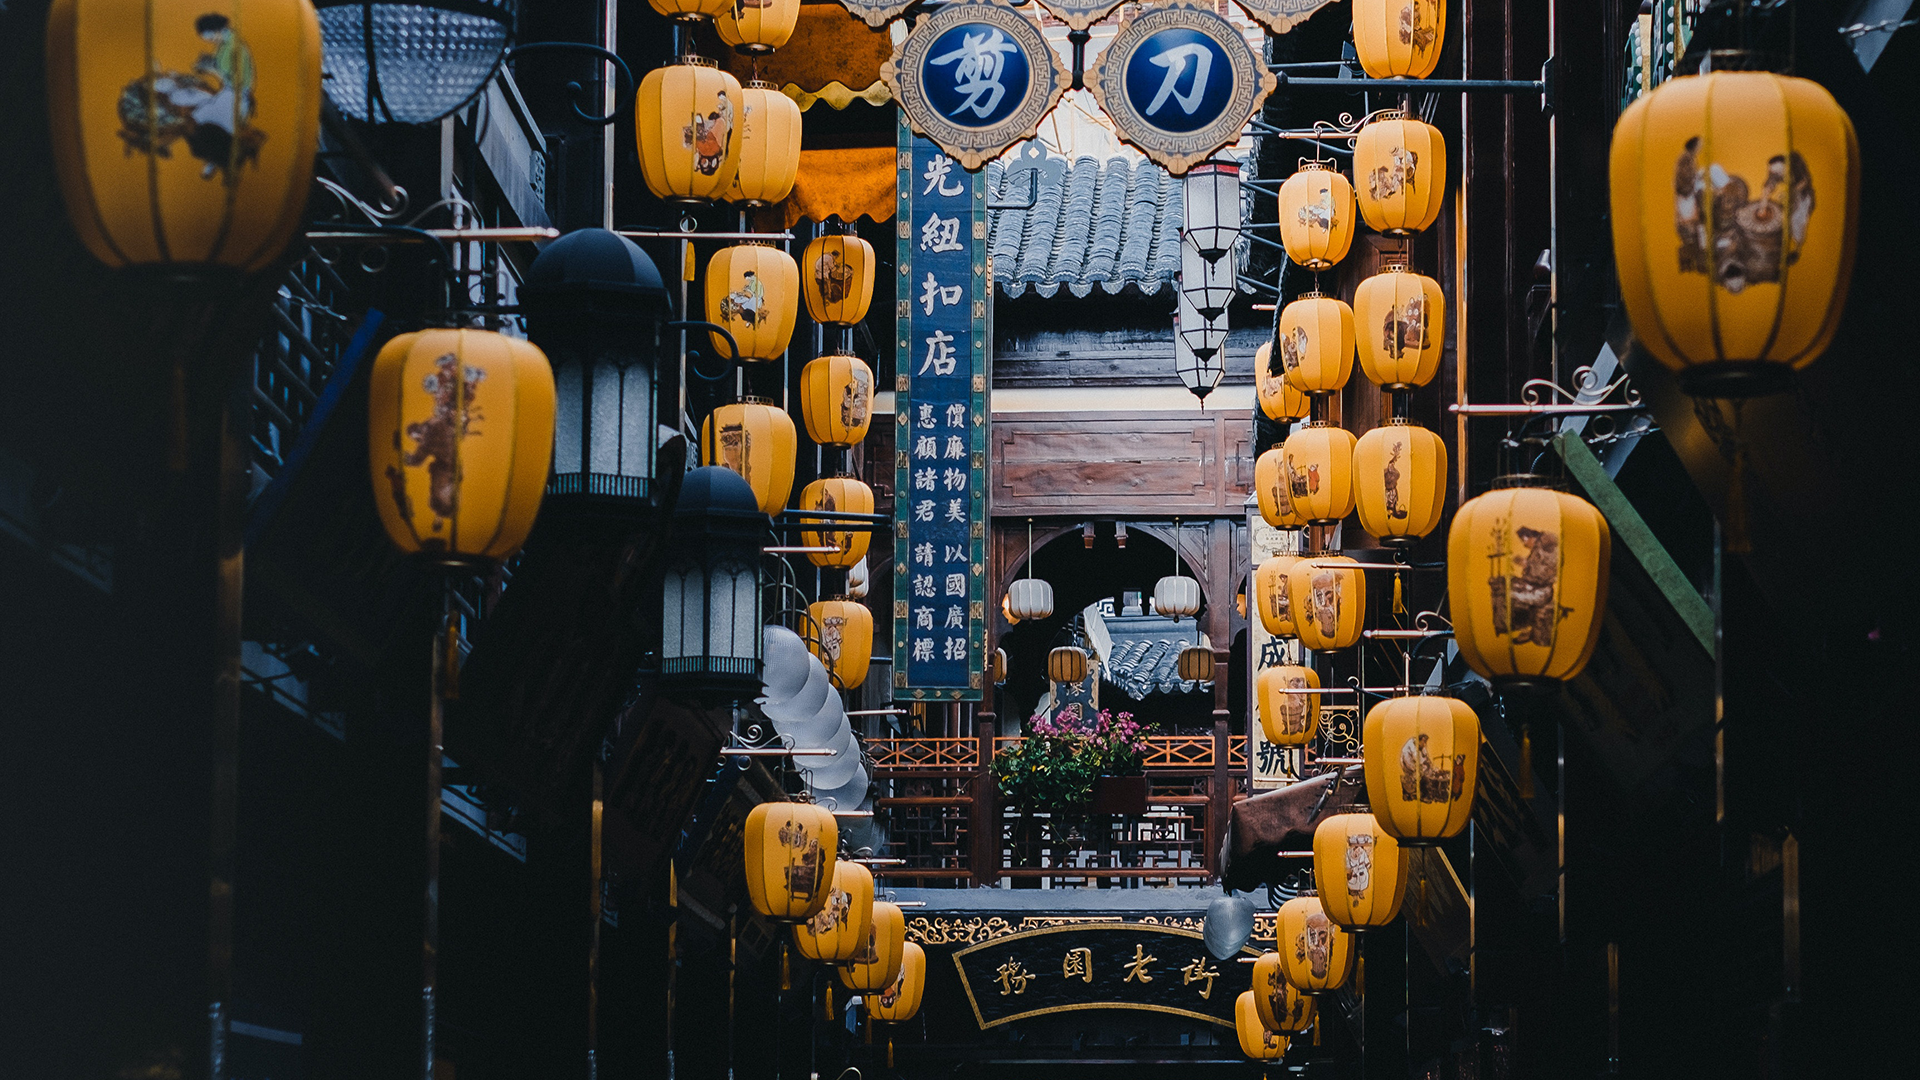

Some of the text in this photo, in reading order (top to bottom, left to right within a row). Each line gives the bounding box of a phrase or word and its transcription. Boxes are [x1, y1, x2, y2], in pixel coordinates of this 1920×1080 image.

[930, 27, 1018, 119] 剪
[1145, 42, 1214, 116] 刀
[918, 153, 964, 377] 光紐扣店
[912, 402, 938, 663] 惠顧諸君 請認商標
[943, 403, 968, 661] 價廉物美 以國廣招
